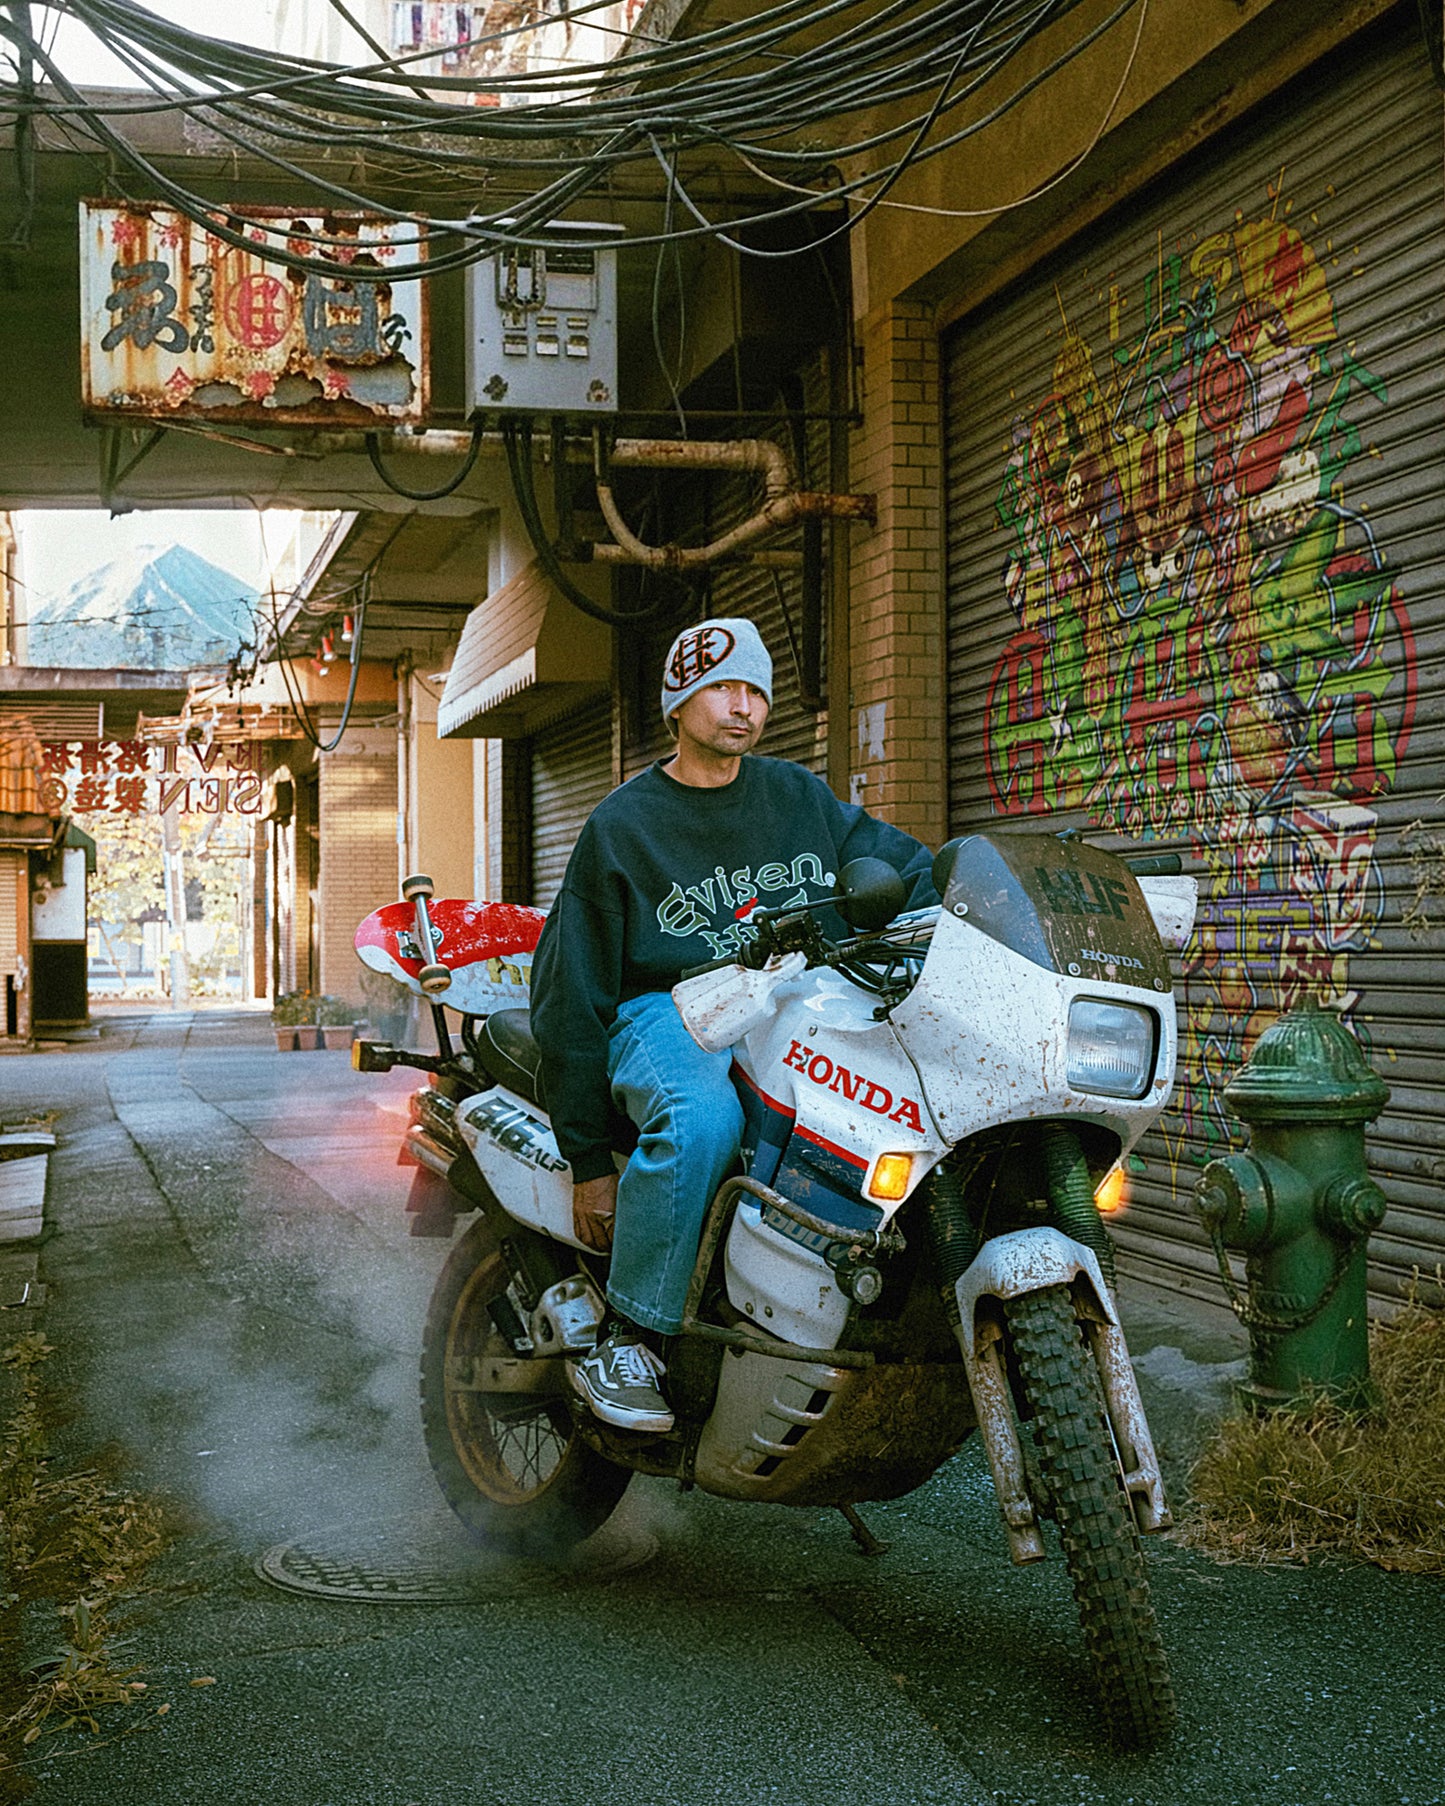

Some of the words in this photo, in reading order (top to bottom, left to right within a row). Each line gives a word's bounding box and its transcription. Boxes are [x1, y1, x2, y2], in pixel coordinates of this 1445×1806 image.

[656, 852, 826, 938] Evisen
[1080, 947, 1145, 971] HONDA
[781, 1038, 926, 1135] HONDA
